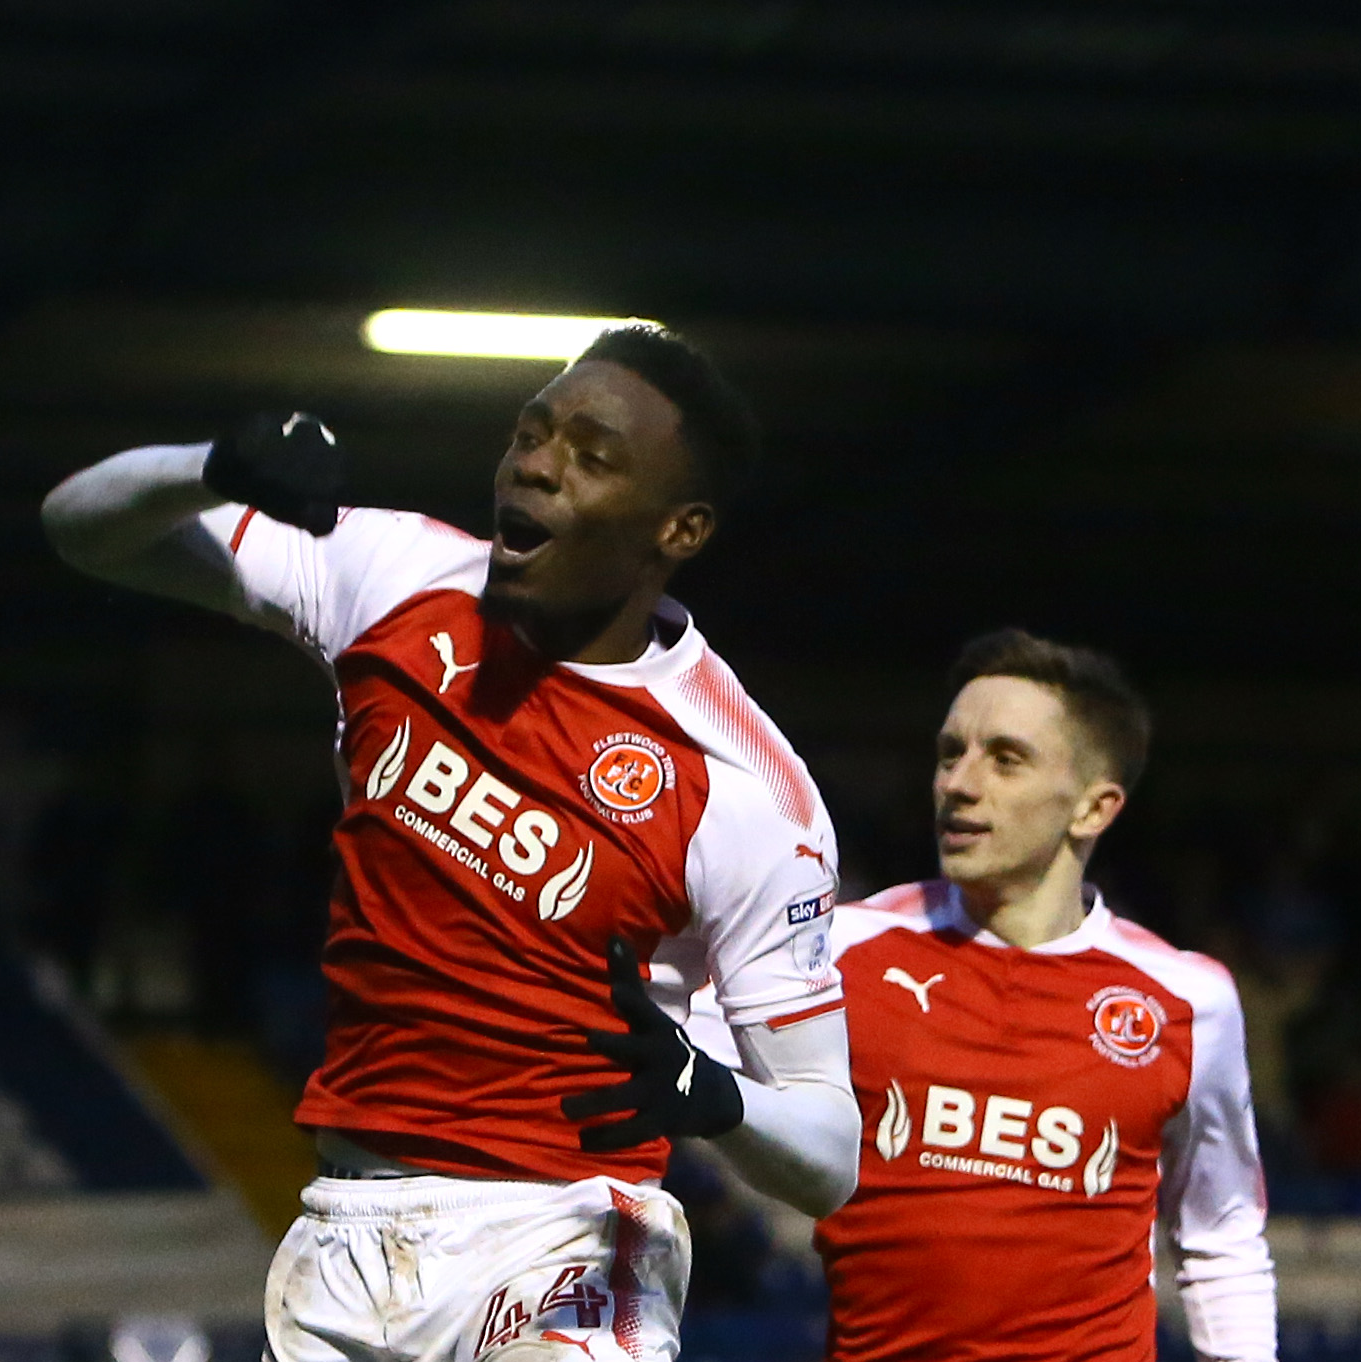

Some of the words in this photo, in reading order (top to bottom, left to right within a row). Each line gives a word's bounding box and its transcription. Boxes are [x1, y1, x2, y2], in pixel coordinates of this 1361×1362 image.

[592, 733, 665, 757] FLEETWOOD
[405, 741, 560, 876] BES
[621, 808, 654, 824] CLUB
[394, 804, 490, 879] COMMERCIAL
[492, 872, 526, 902] GAS
[790, 902, 816, 922] sky
[922, 1084, 1084, 1168] BES
[919, 1151, 1033, 1185] COMMERCIAL
[1038, 1172, 1074, 1192] GAS
[473, 1265, 608, 1359] 44
